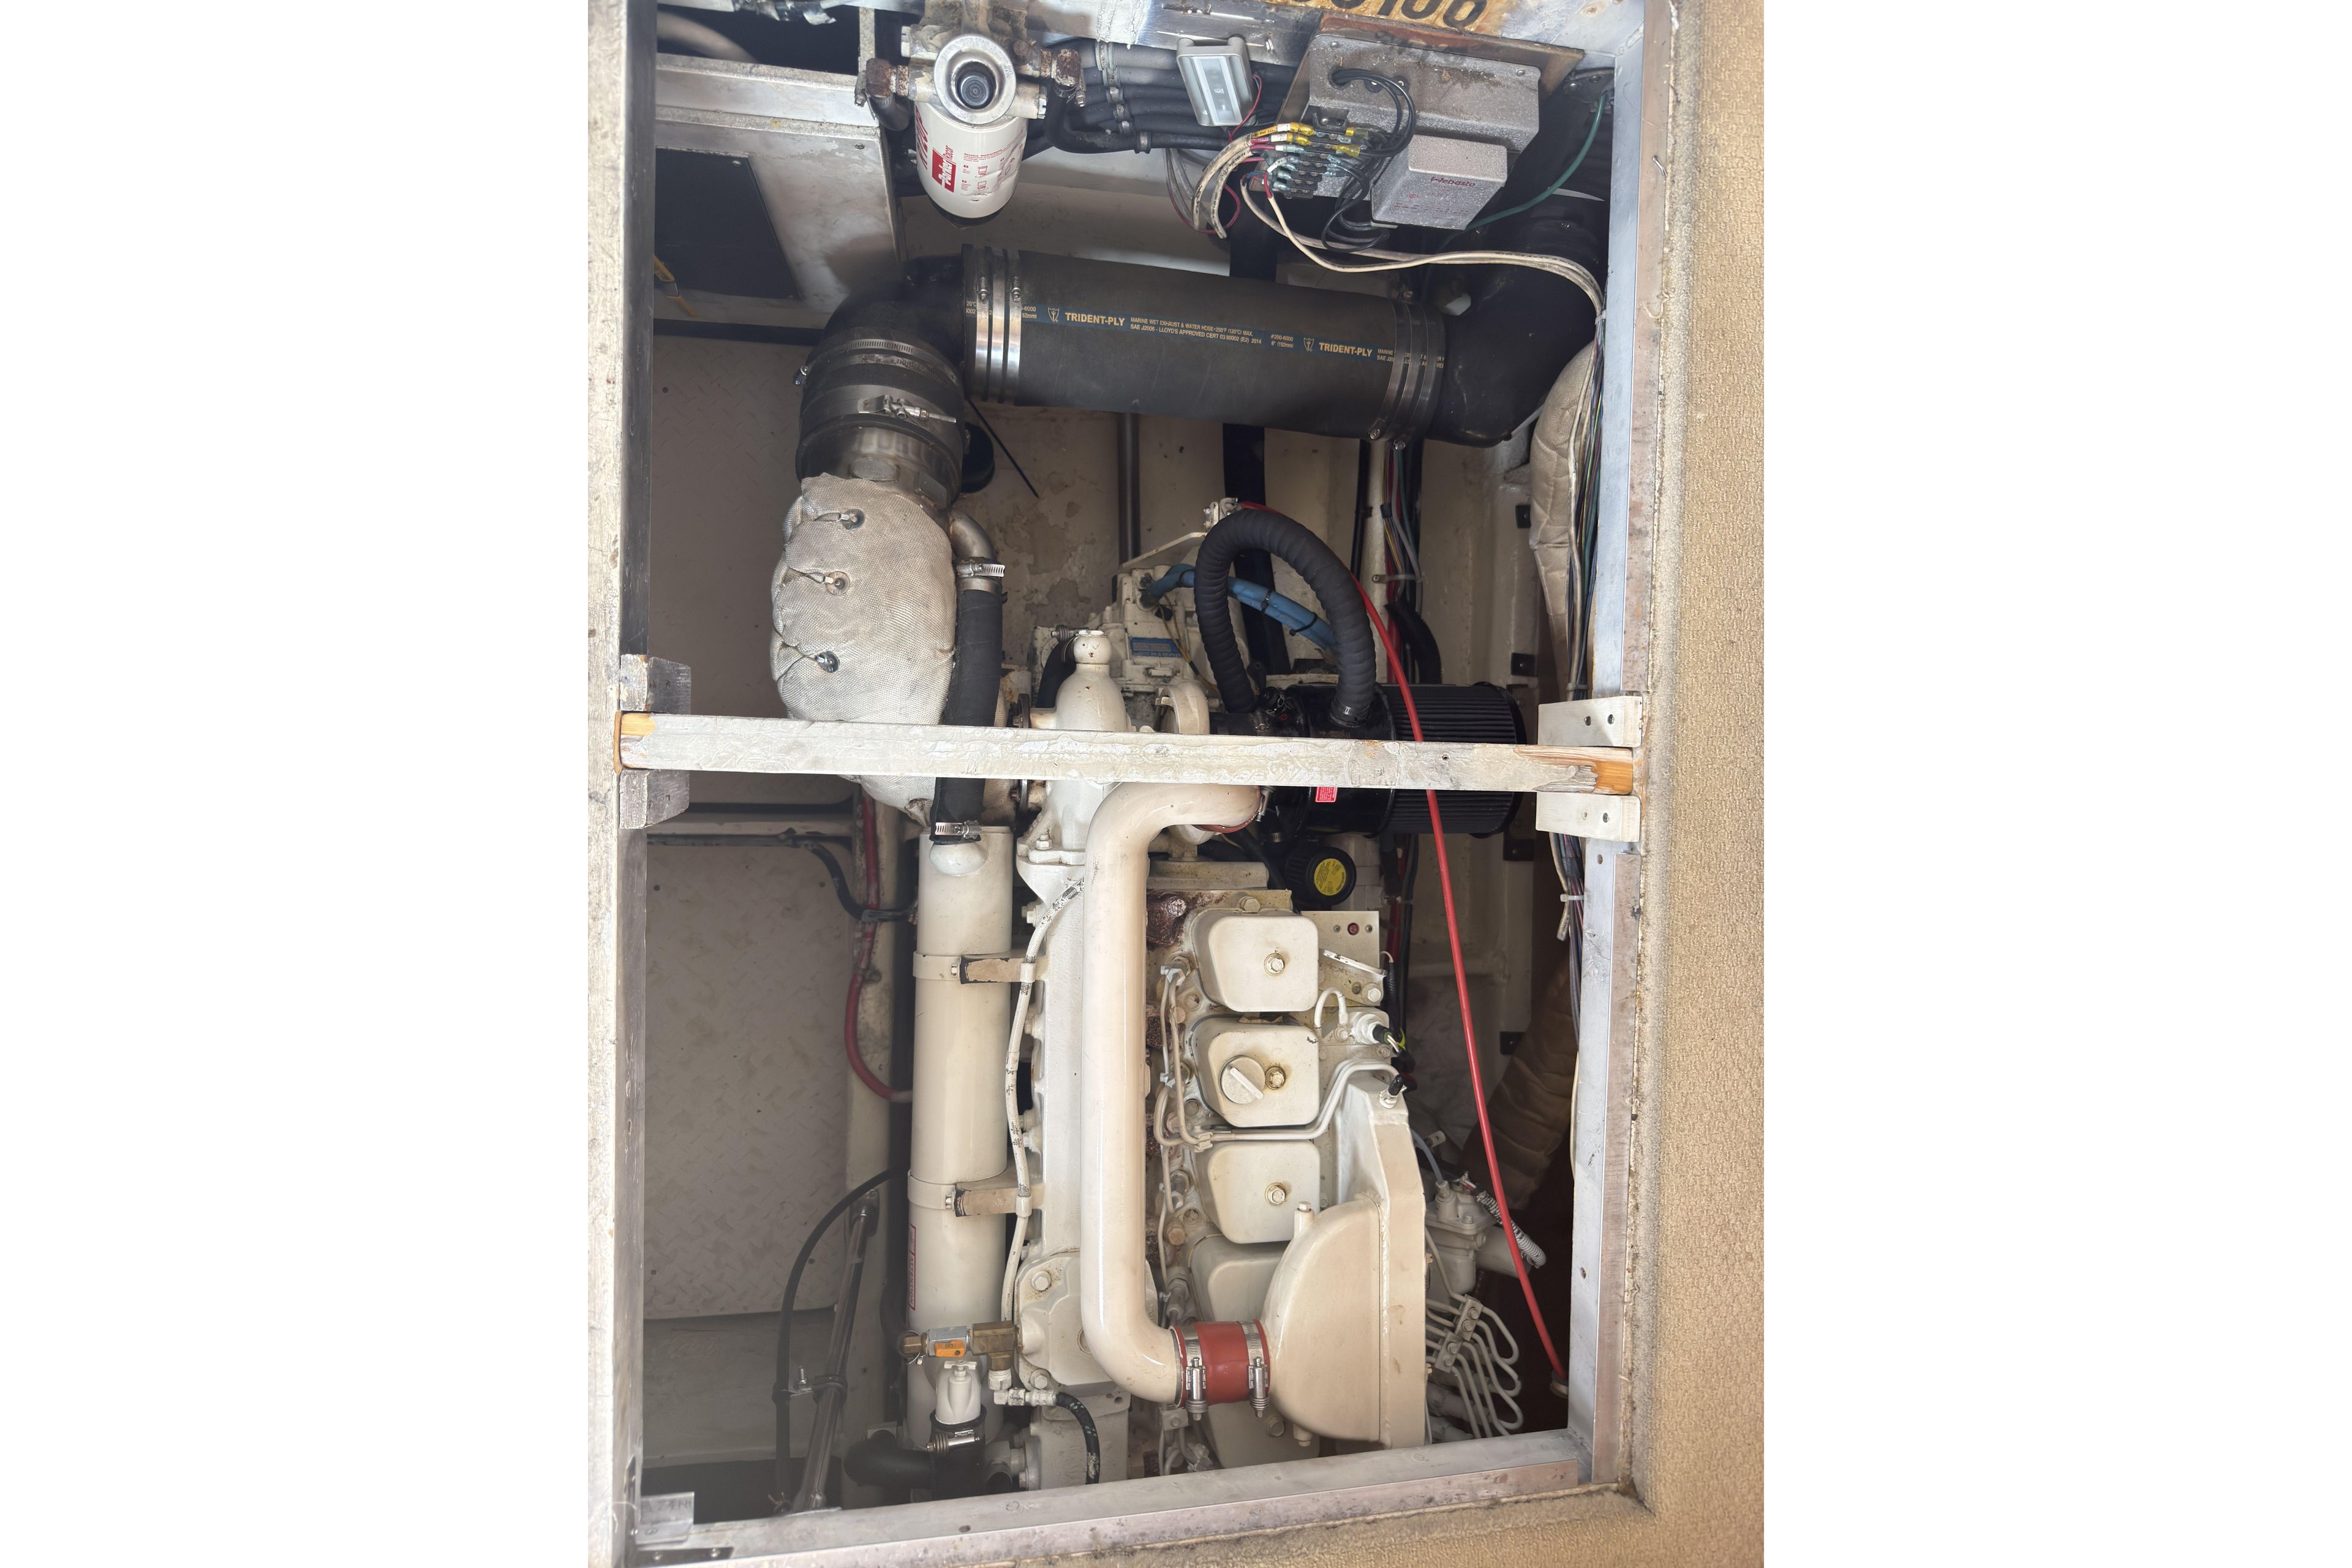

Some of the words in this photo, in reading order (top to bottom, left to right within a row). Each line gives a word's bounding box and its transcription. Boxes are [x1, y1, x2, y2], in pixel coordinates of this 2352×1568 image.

[943, 145, 954, 162] Racor
[938, 158, 953, 186] Parker
[1431, 176, 1476, 187] Webasto
[1065, 312, 1125, 326] TRIDENT-PLY
[1178, 329, 1205, 337] APPROVED
[1319, 342, 1373, 358] TRIDENT-PLY
